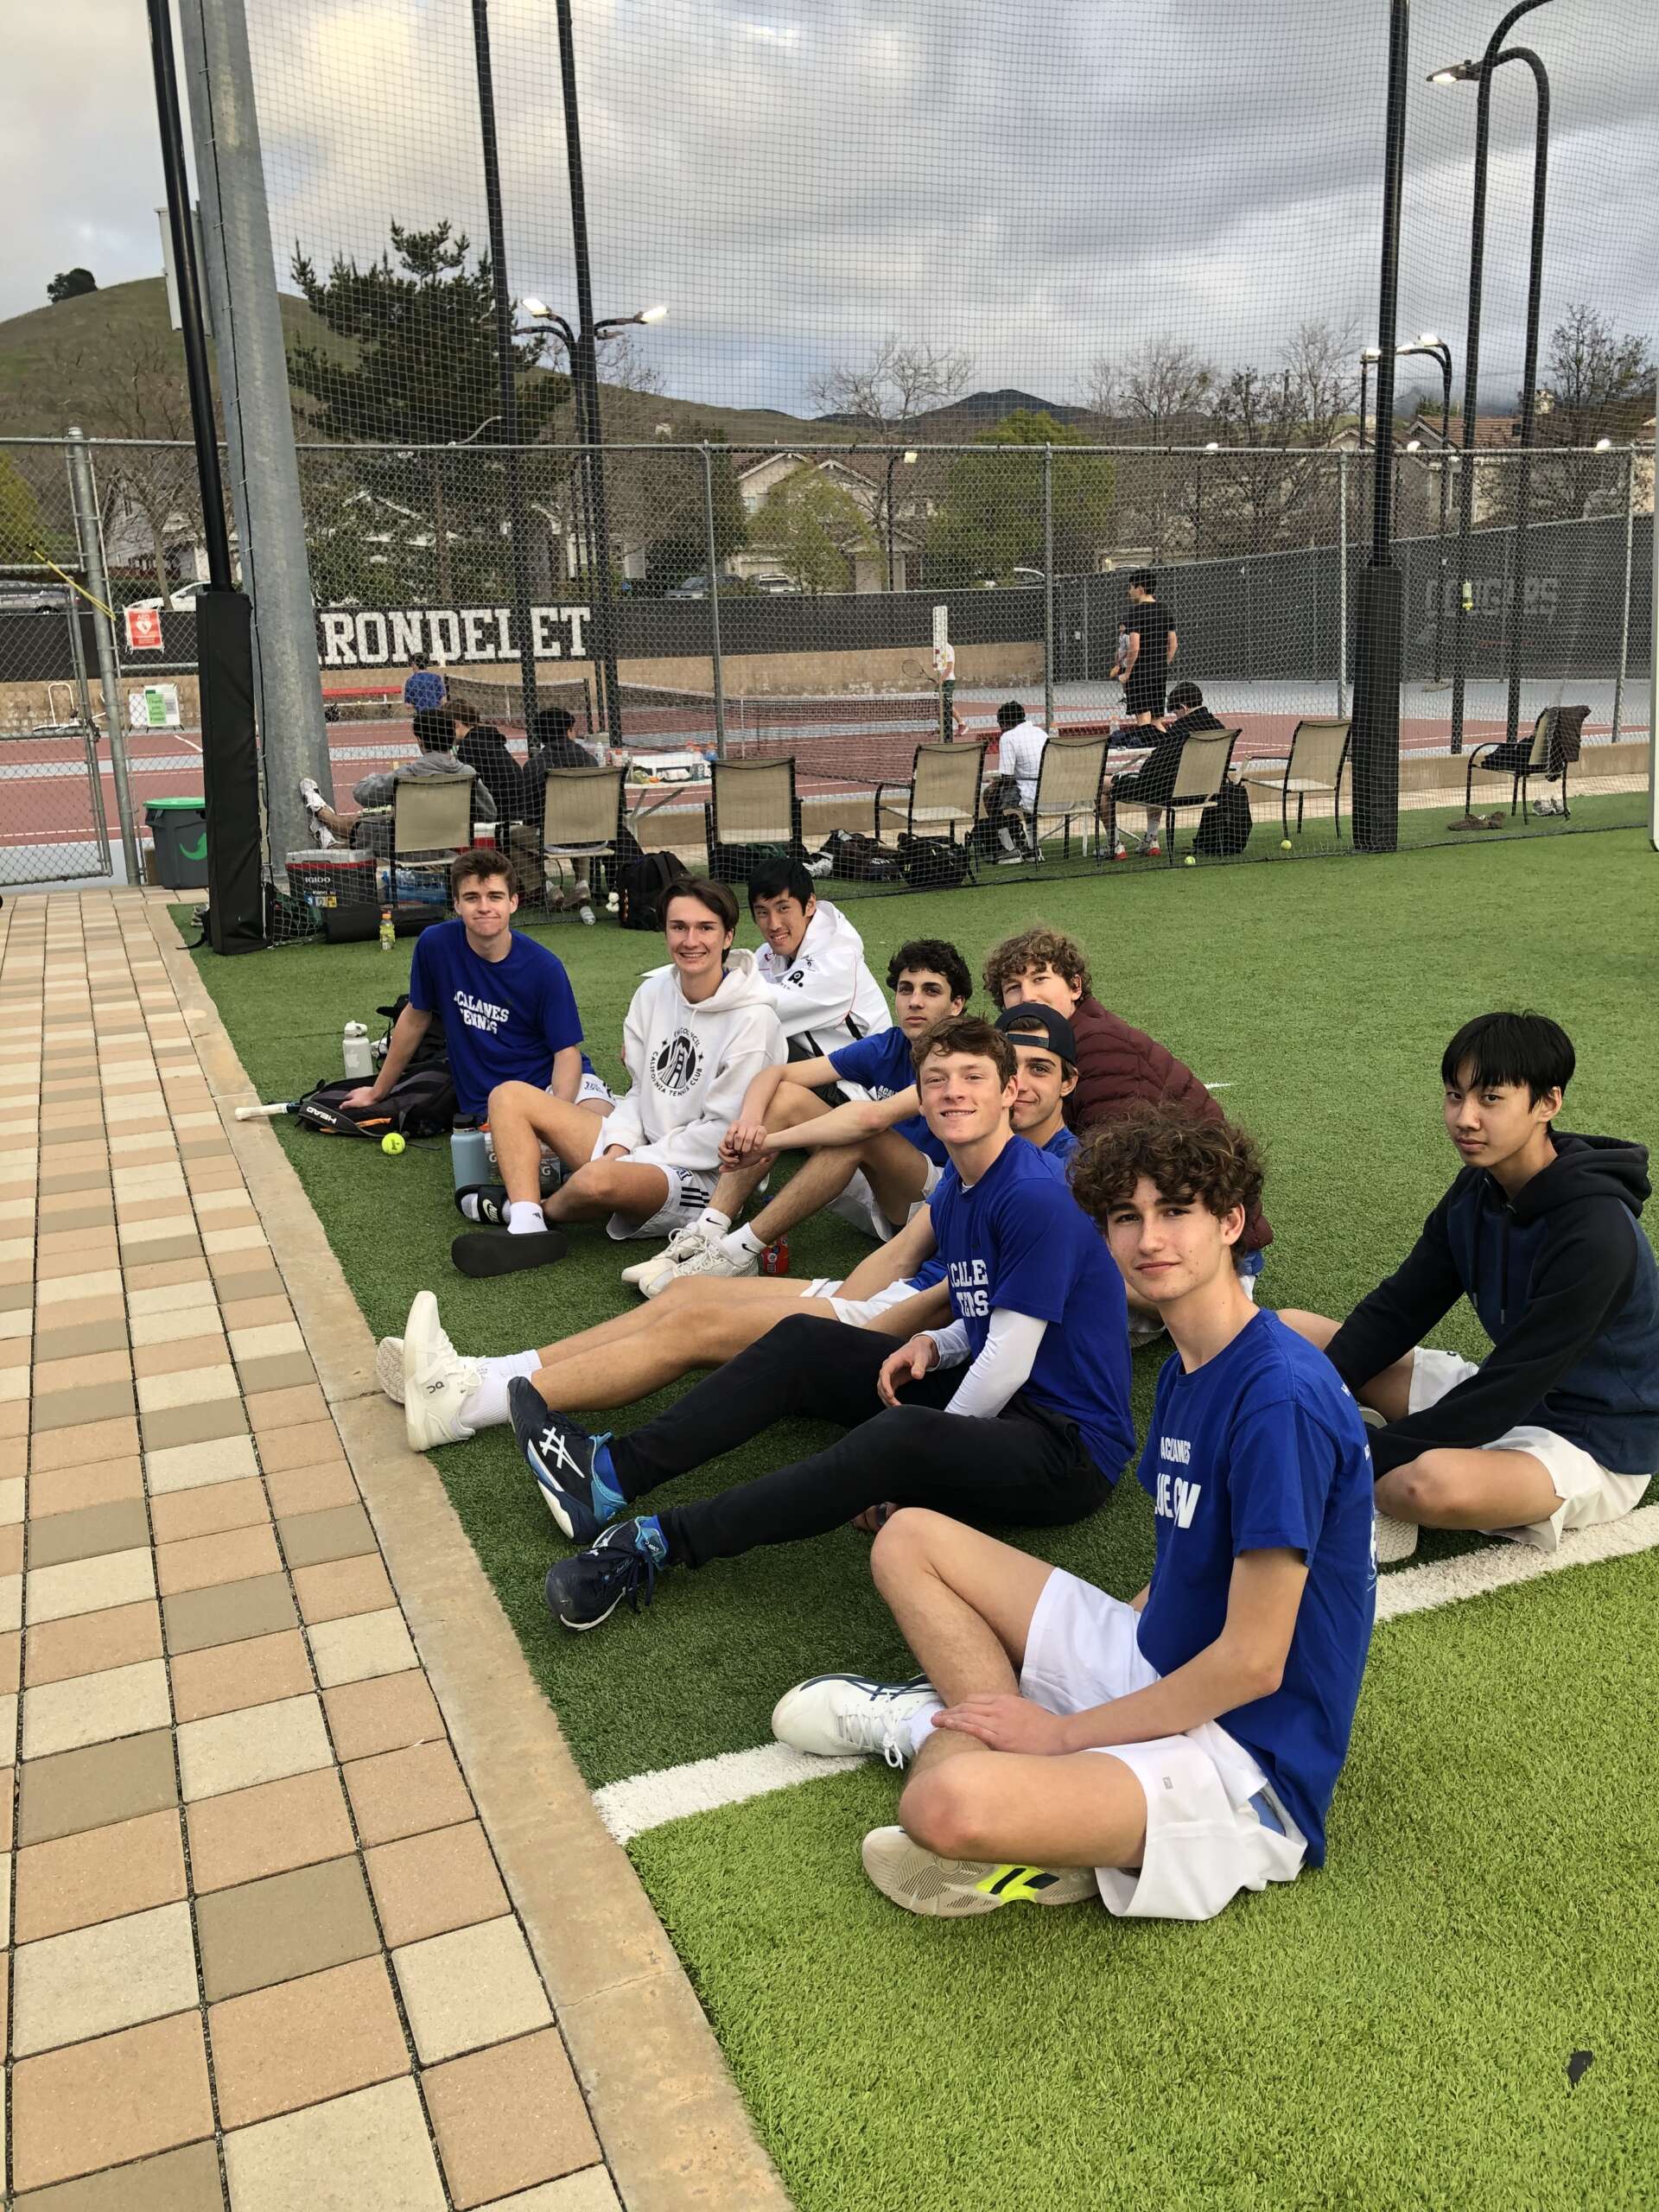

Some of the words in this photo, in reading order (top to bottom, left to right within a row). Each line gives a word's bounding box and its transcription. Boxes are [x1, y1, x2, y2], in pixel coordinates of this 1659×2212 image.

[317, 607, 592, 666] RONDELET
[690, 1068, 702, 1086] CLUB
[306, 1106, 337, 1124] HEAD
[542, 1166, 551, 1176] G
